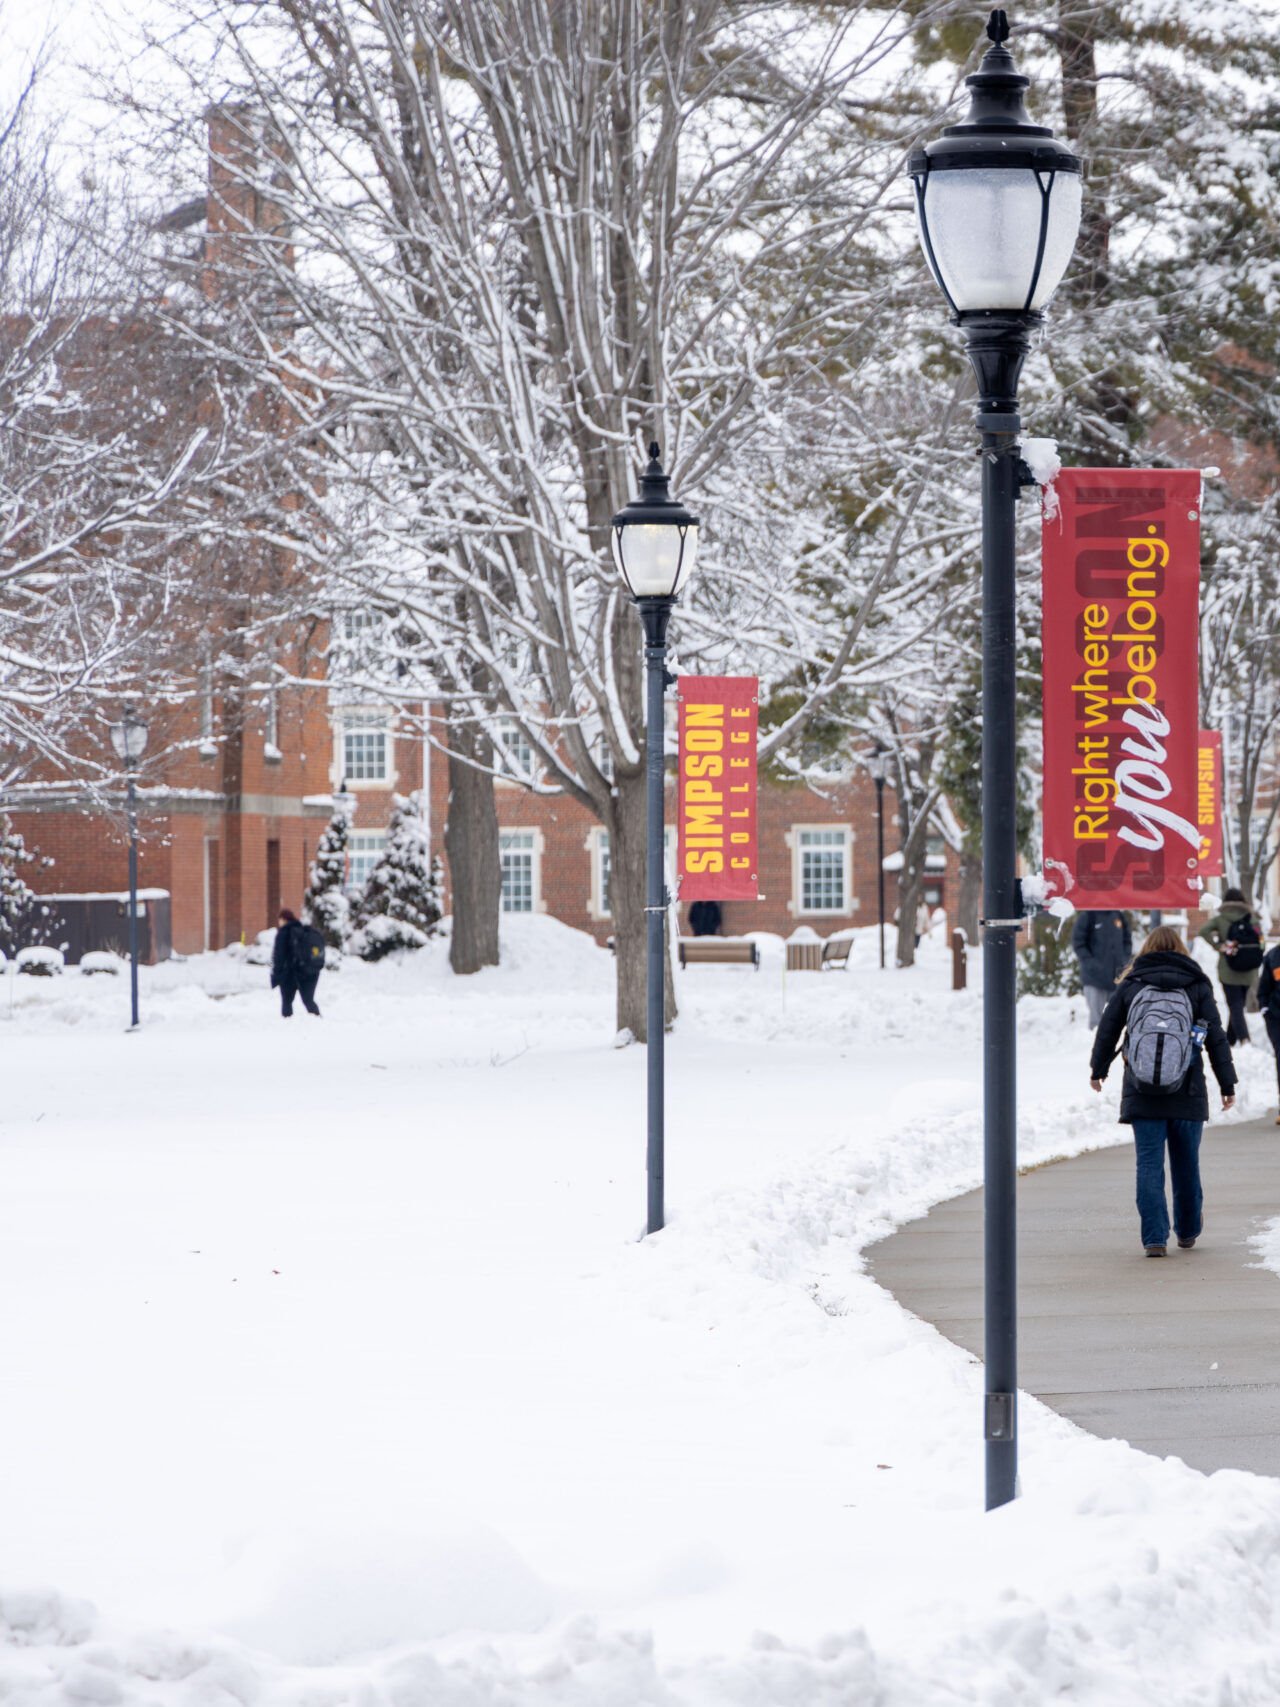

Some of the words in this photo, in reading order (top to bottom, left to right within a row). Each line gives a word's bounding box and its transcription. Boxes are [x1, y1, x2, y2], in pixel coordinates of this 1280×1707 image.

[1072, 603, 1109, 728] where
[1112, 525, 1170, 705] belong.
[685, 704, 724, 873] SIMPSON
[730, 707, 750, 868] COLLEGE
[1072, 736, 1119, 840] Right
[1114, 697, 1201, 850] you
[1198, 748, 1215, 825] SIMPSON
